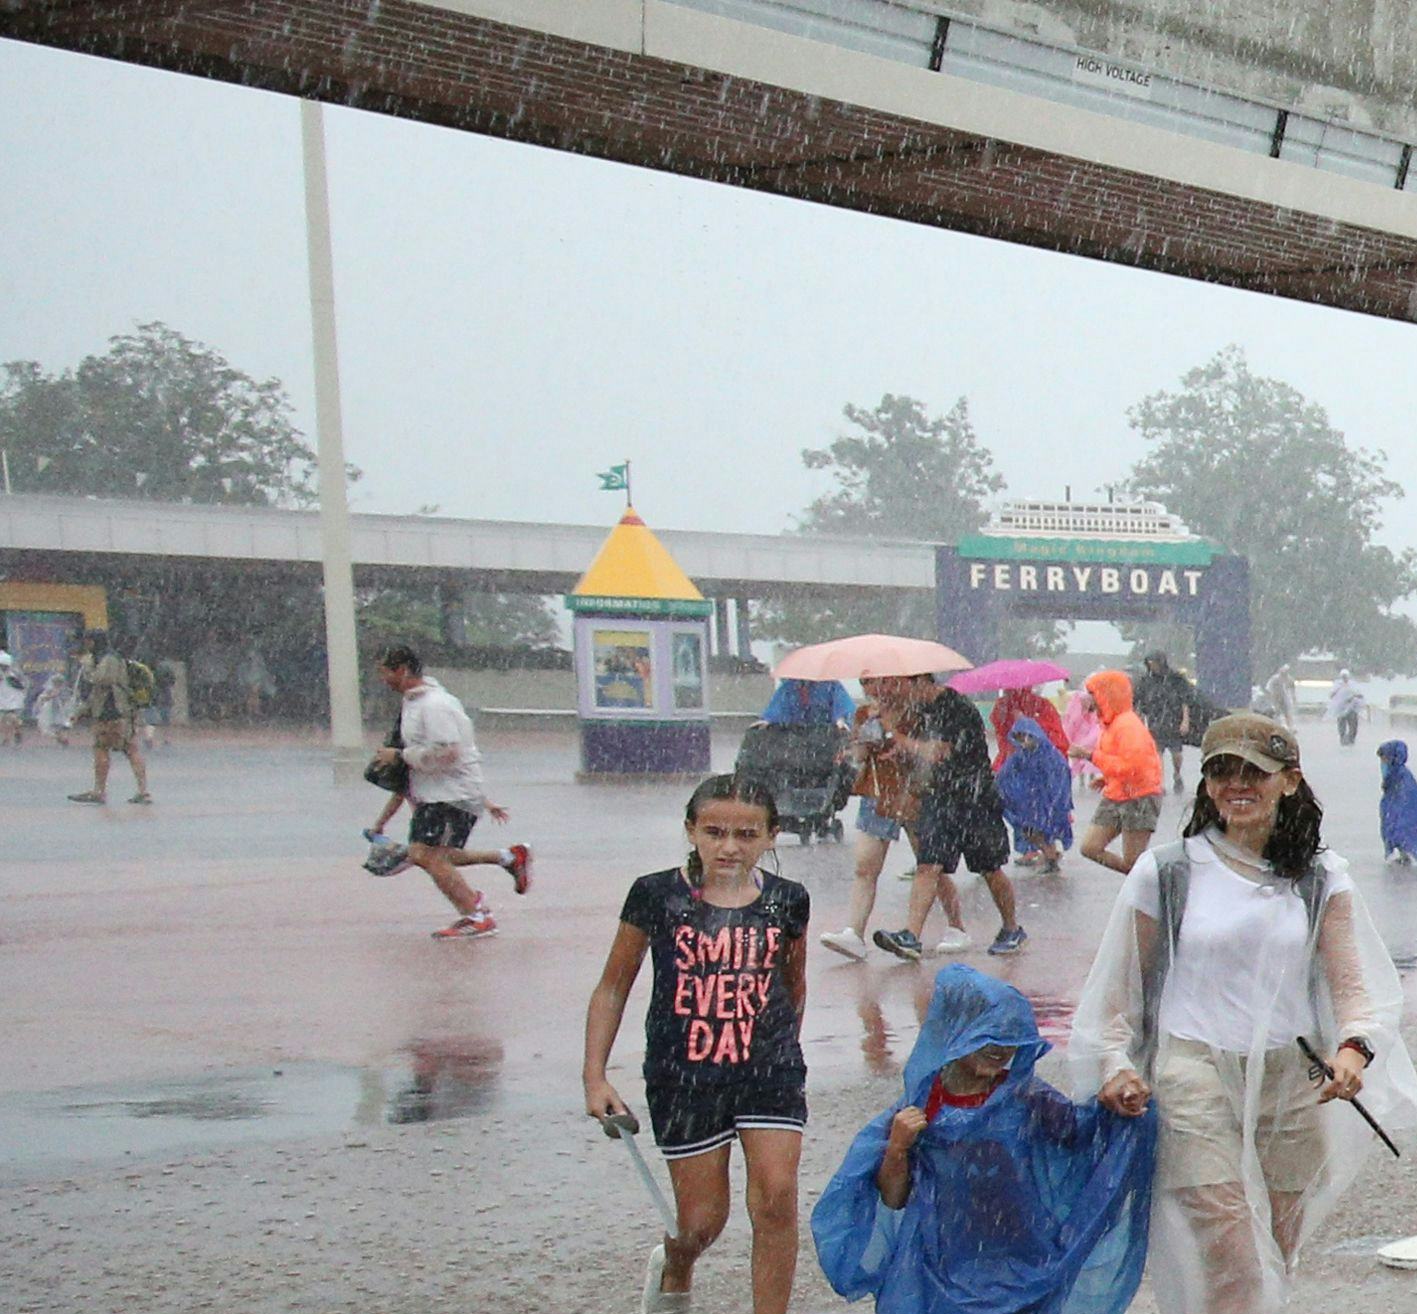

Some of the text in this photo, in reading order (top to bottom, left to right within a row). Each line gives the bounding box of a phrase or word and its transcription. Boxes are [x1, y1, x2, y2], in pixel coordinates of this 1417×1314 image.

[1076, 58, 1151, 87] HIGH VOLTAGE
[970, 563, 1202, 595] FERRYBOAT
[674, 924, 782, 972] SMILE
[674, 972, 772, 1019] EVERY
[687, 1019, 755, 1064] DAY
